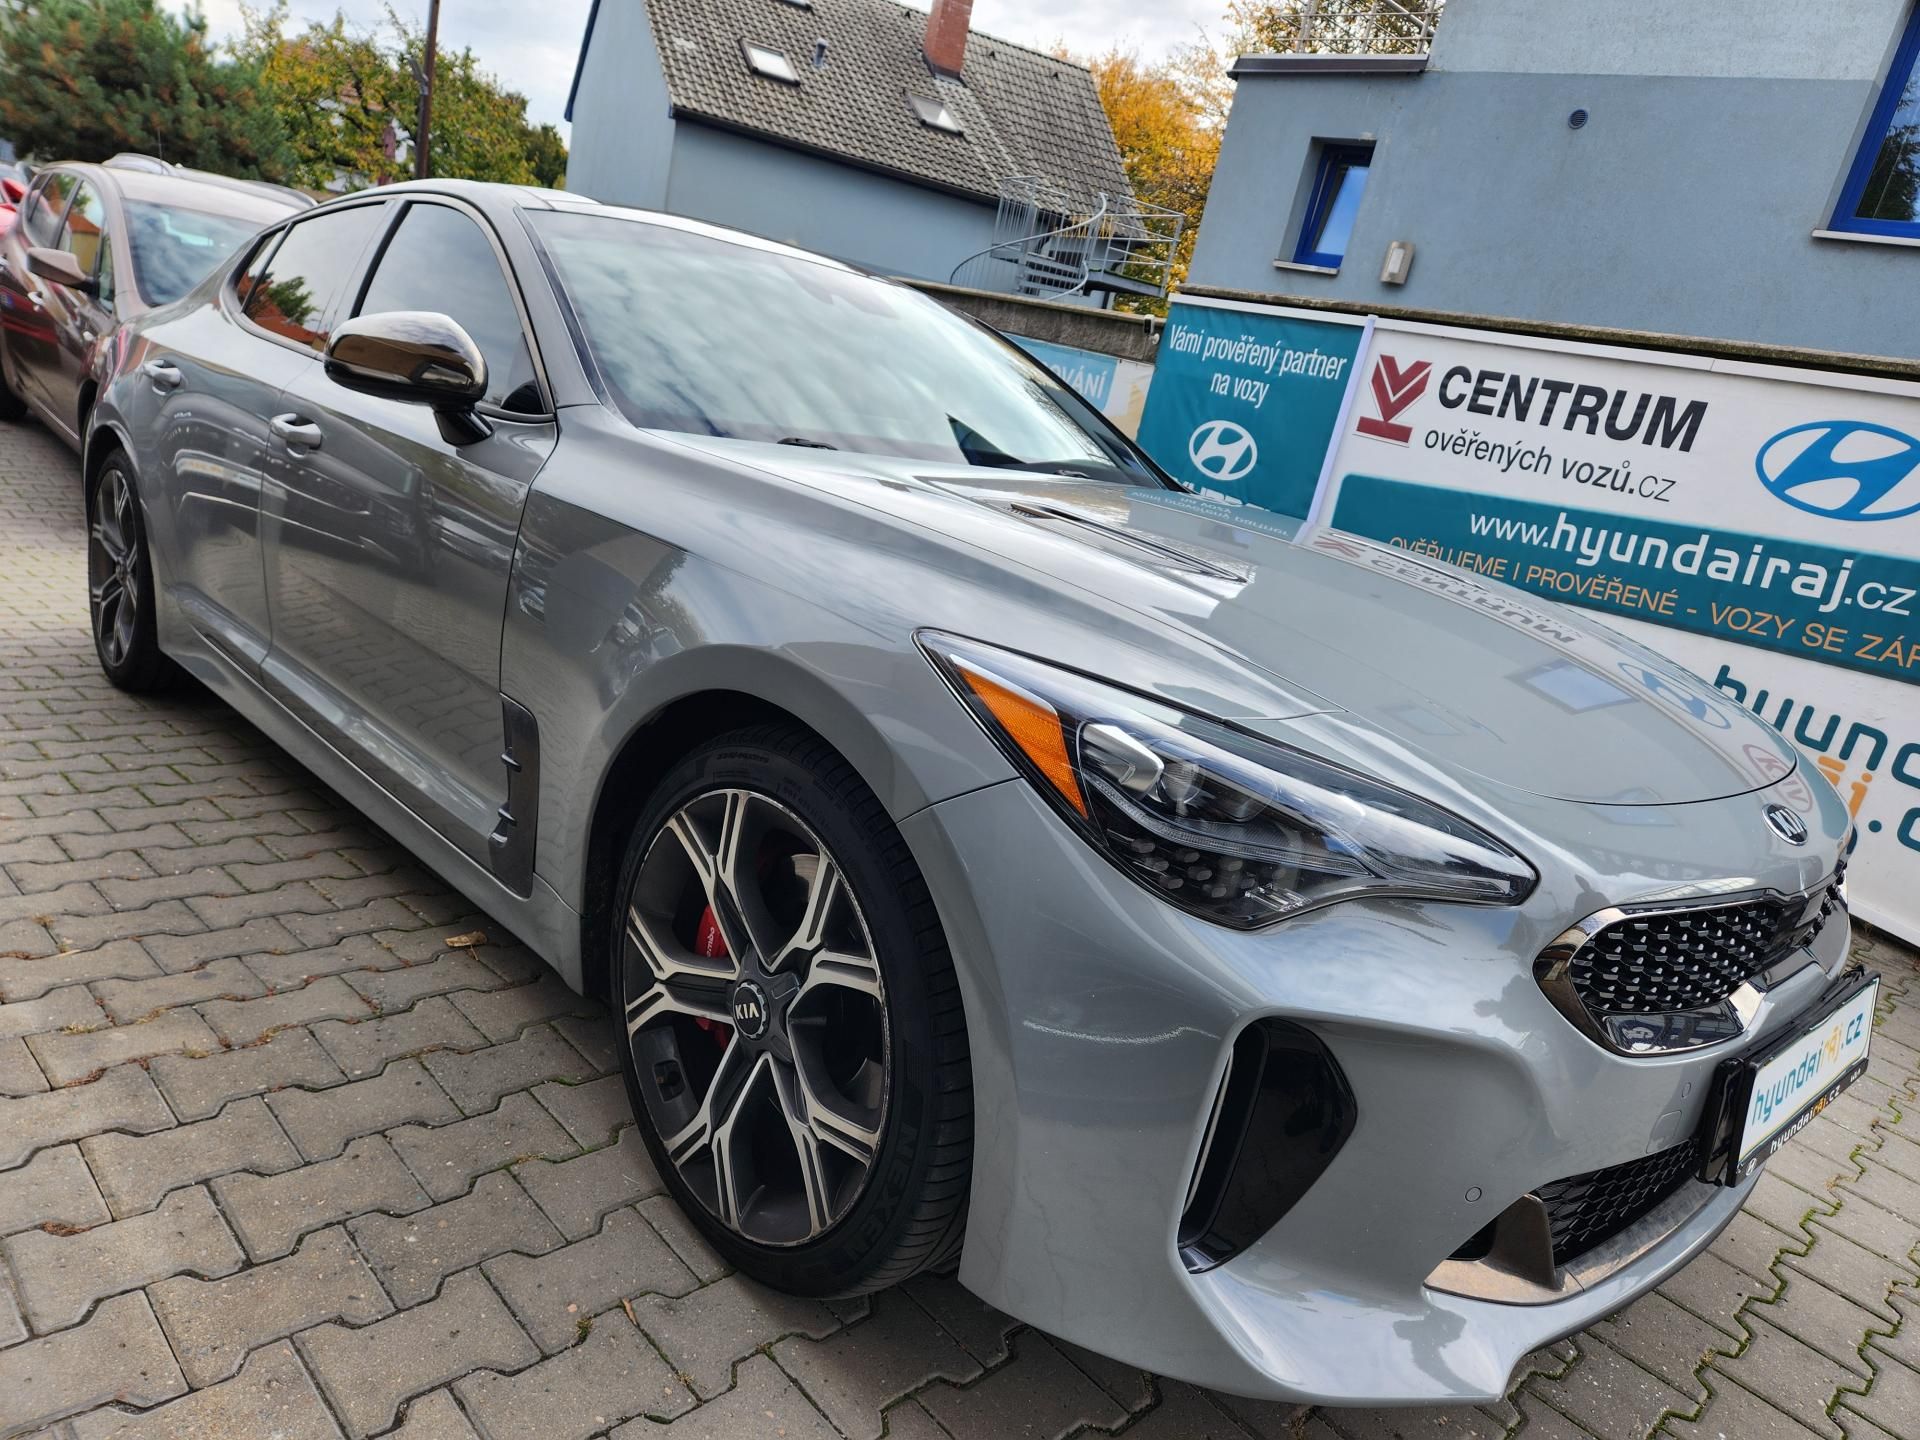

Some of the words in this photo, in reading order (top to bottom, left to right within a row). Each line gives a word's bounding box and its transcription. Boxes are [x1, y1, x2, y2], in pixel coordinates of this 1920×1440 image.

[1169, 324, 1205, 354] Vámi
[1202, 334, 1281, 374] prověřený
[1279, 348, 1347, 380] partner
[1210, 372, 1230, 395] na
[1233, 377, 1270, 409] vozy
[1438, 366, 1709, 453] CENTRUM
[1424, 428, 1552, 475] ověřených
[1470, 512, 1917, 616] www.hyundairaj.cz
[1525, 565, 1679, 615] PROVĚŘENÉ
[1711, 602, 1796, 639] VOZY
[1801, 622, 1849, 652] SE
[735, 1002, 760, 1020] KIA
